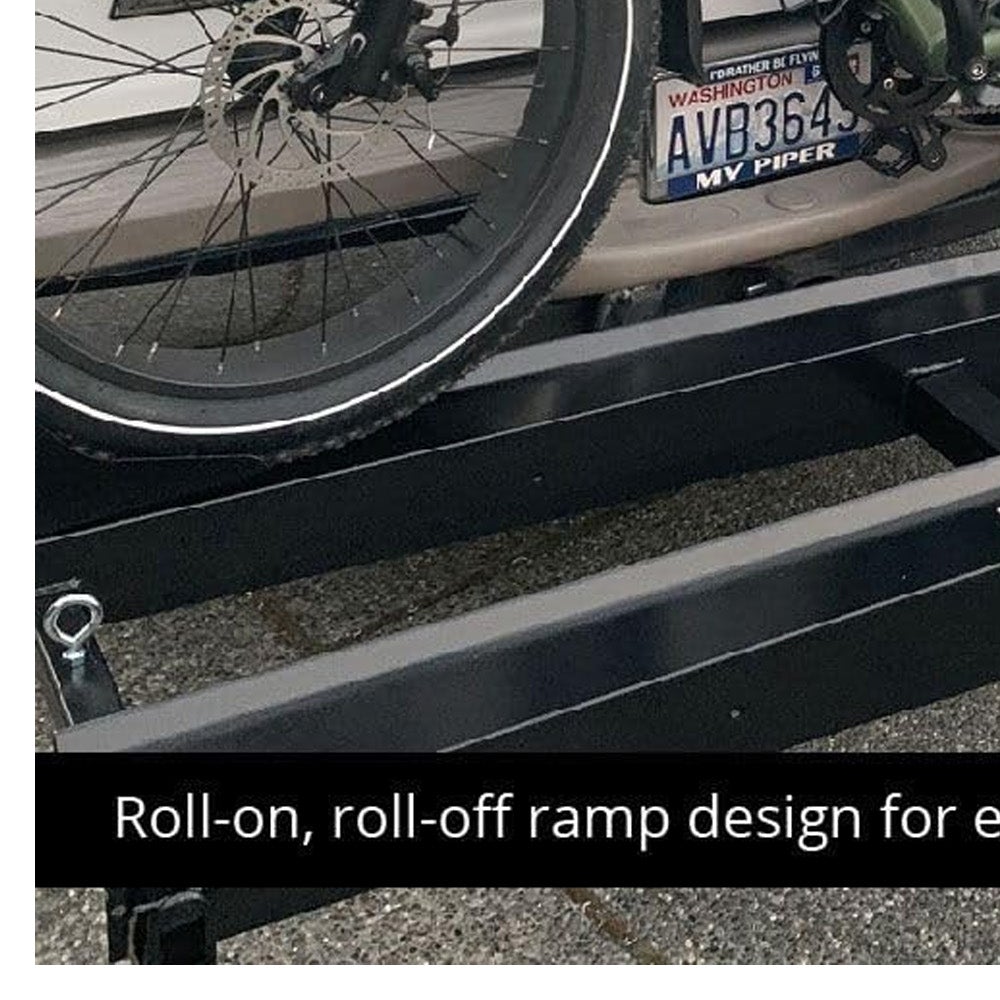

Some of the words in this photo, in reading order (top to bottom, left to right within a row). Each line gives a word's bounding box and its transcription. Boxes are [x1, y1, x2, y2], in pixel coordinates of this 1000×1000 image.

[725, 59, 770, 77] RATHER
[789, 48, 819, 66] FLYIN
[668, 71, 793, 108] WASHINGTON
[696, 162, 745, 190] MY
[754, 142, 836, 176] PIPER
